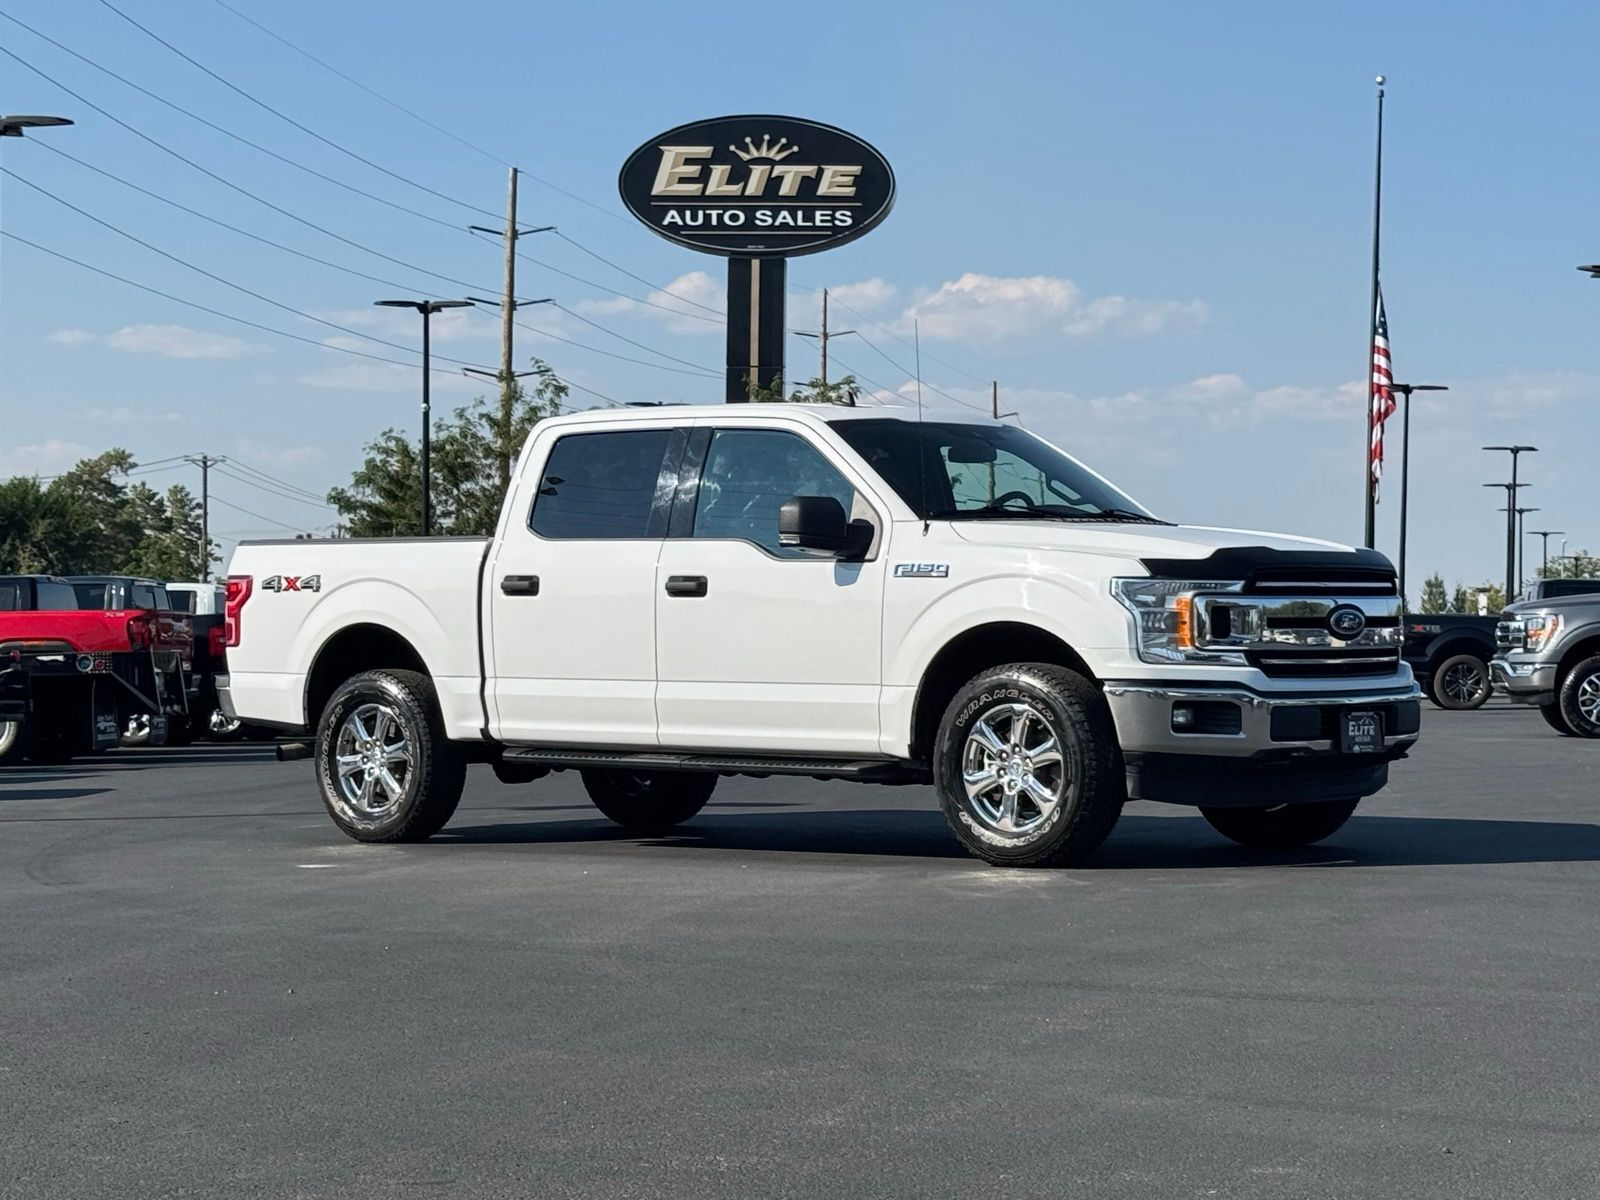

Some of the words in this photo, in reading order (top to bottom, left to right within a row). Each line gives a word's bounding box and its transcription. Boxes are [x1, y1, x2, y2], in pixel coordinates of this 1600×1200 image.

[651, 145, 863, 197] ELITE
[662, 209, 746, 226] AUTO
[754, 209, 853, 227] SALES
[955, 688, 1055, 727] WRANGLER
[1348, 721, 1375, 736] ELITE
